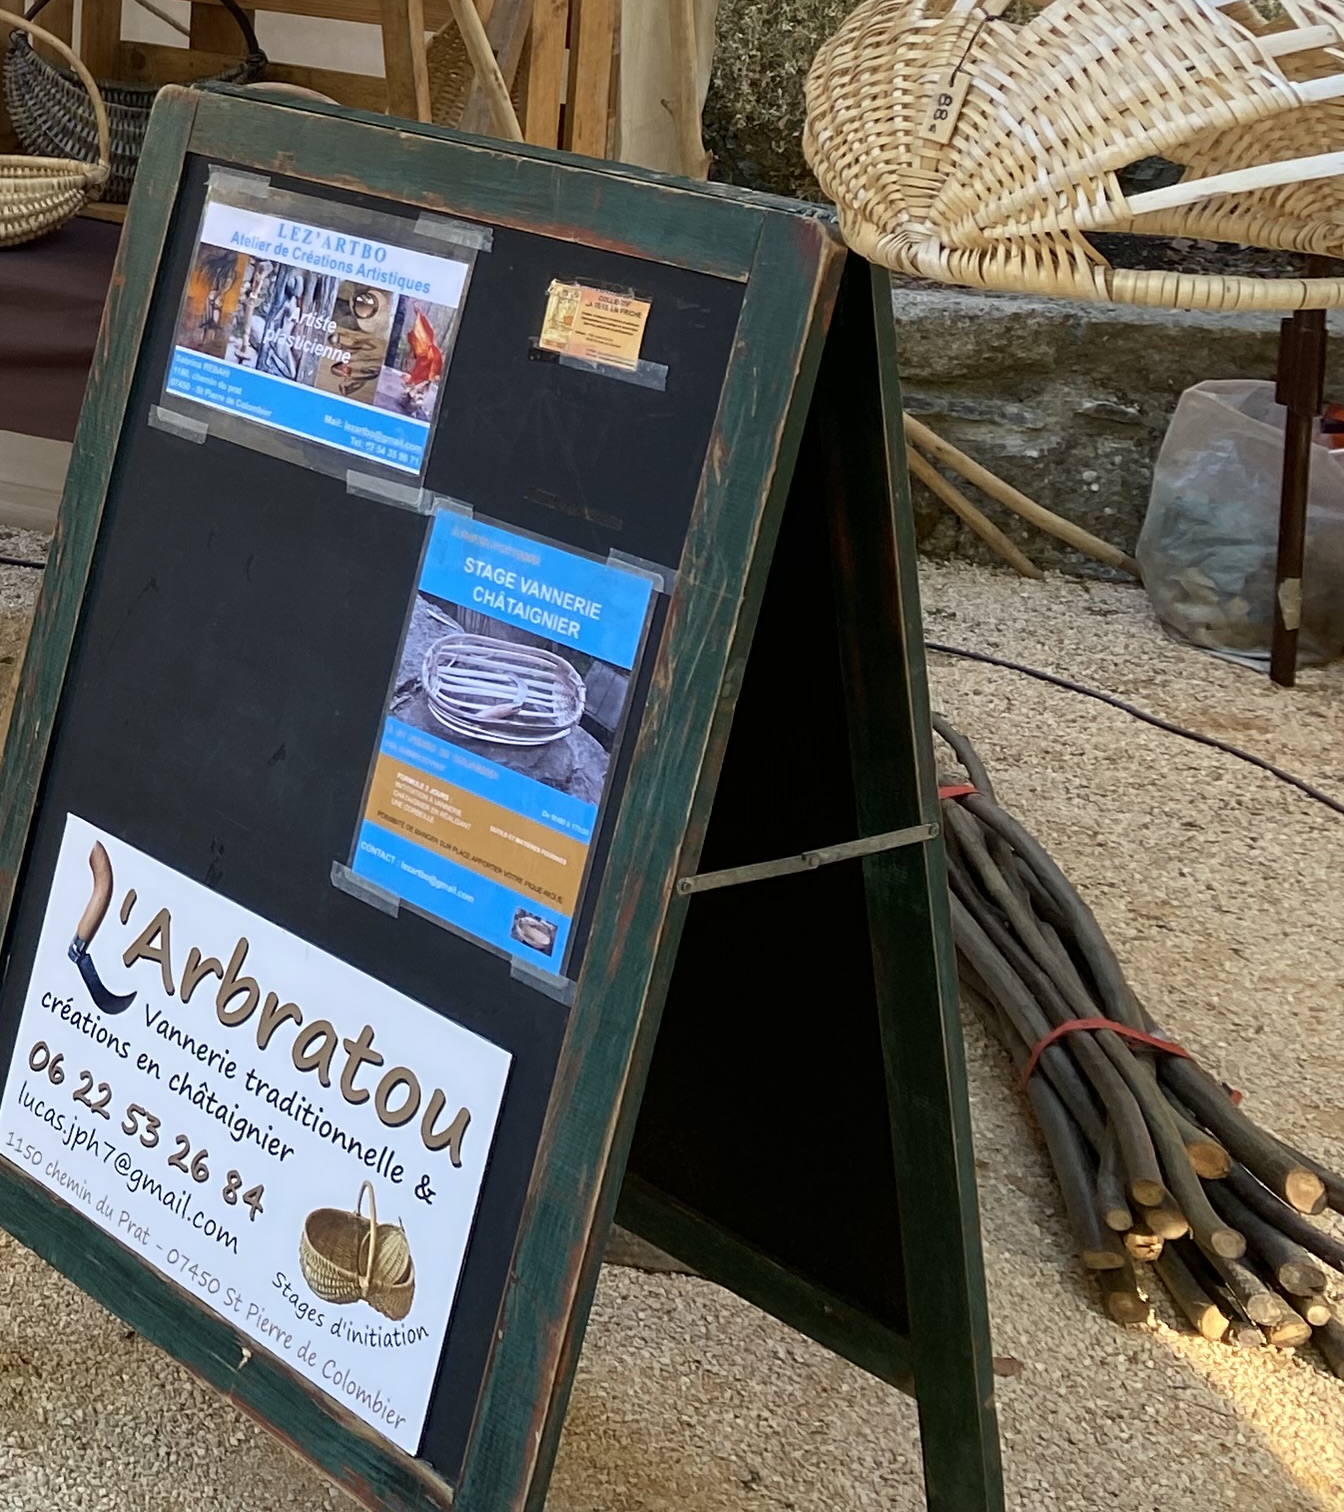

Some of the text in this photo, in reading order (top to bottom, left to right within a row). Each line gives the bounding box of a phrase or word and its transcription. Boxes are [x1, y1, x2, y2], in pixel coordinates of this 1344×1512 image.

[230, 230, 430, 293] Atelier de Créations Artistiques
[277, 222, 386, 263] LEZ'ARTBO
[264, 328, 351, 364] plasticienne
[289, 308, 337, 332] Artiste
[464, 557, 602, 620] STAGE VANNERIE
[472, 586, 580, 639] CHÂTAIGNIER
[360, 840, 395, 864] CONTACT
[41, 991, 294, 1161] créations en châtaignier
[145, 1002, 436, 1205] Vannerie traditionnelle &
[28, 1040, 264, 1222] 06 22 53 26 84
[18, 1079, 237, 1254] lucas.jph7@gmail.com
[5, 1131, 42, 1165] 1150
[45, 1159, 91, 1204] chemin
[95, 1194, 113, 1220] du
[117, 1209, 150, 1245] Prat
[166, 1248, 220, 1294] 07450
[223, 1287, 242, 1312] St
[245, 1302, 292, 1349] Pierre
[296, 1340, 316, 1367] de
[321, 1359, 406, 1428] Colombier
[271, 1271, 429, 1348] Stages d'initiation
